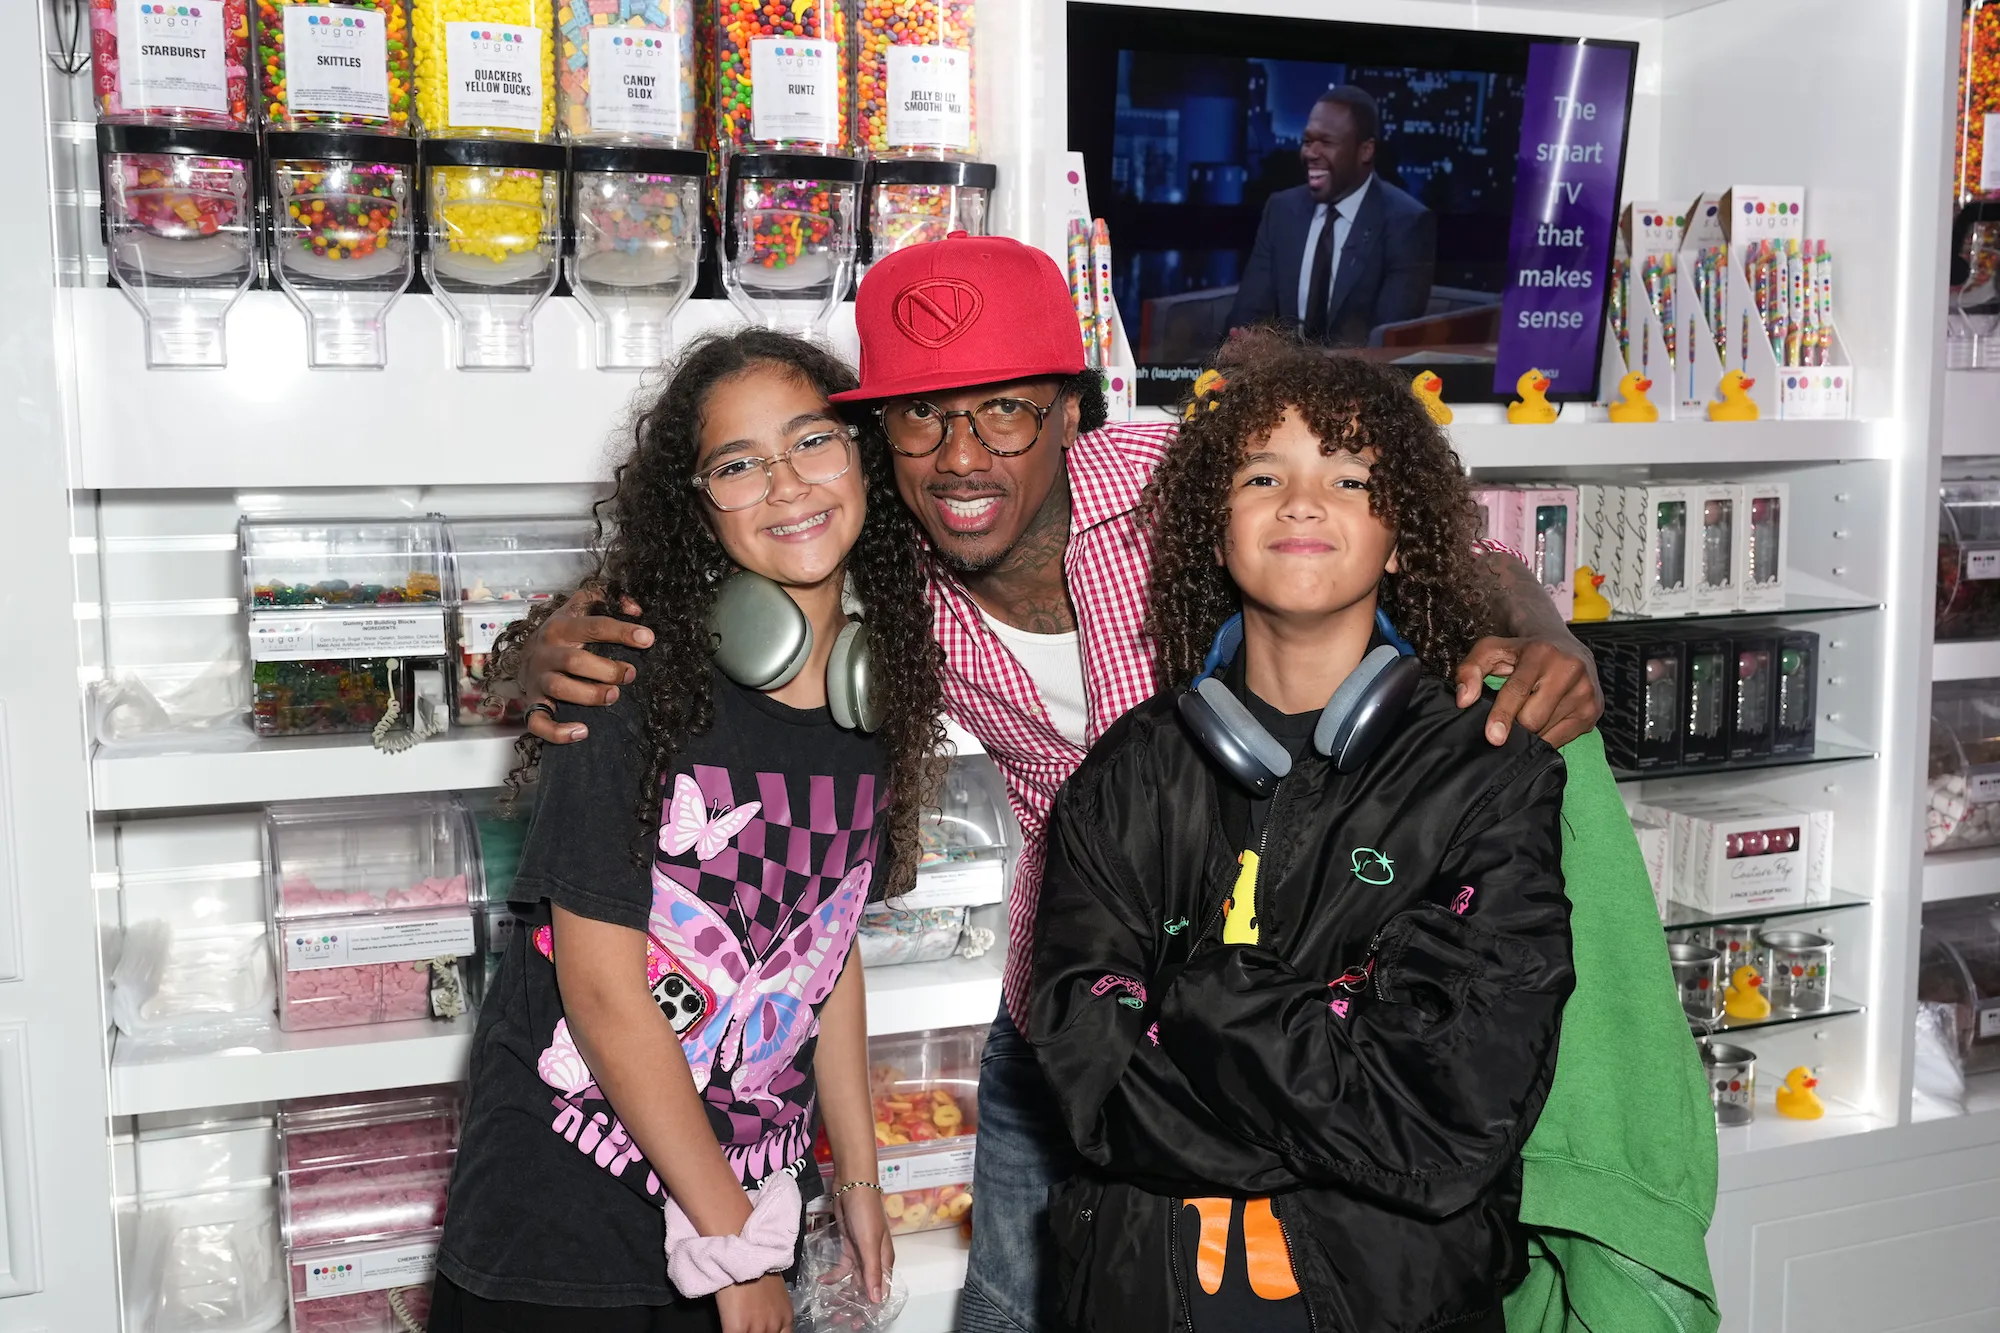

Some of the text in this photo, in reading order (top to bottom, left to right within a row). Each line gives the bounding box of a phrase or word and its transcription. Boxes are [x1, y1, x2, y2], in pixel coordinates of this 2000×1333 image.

[143, 16, 198, 27] sugar
[310, 27, 362, 38] sugar
[141, 45, 206, 59] STARBURST
[472, 42, 520, 52] sugar
[615, 49, 661, 58] sugar
[317, 55, 361, 68] SKITTLES
[474, 69, 523, 83] QUACKERS
[623, 74, 656, 87] CANDY
[465, 81, 531, 96] YELLOW DUCKS
[627, 88, 653, 99] BLOX
[788, 84, 815, 95] RUNTZ
[911, 90, 932, 101] JELLY
[904, 101, 961, 114] SMOOTHI MIX
[1554, 96, 1596, 121] The
[1536, 142, 1603, 164] smart
[1551, 182, 1583, 205] TV
[1745, 217, 1798, 229] sugar
[1537, 224, 1584, 247] that
[1519, 265, 1592, 288] makes
[1518, 310, 1584, 329] sense
